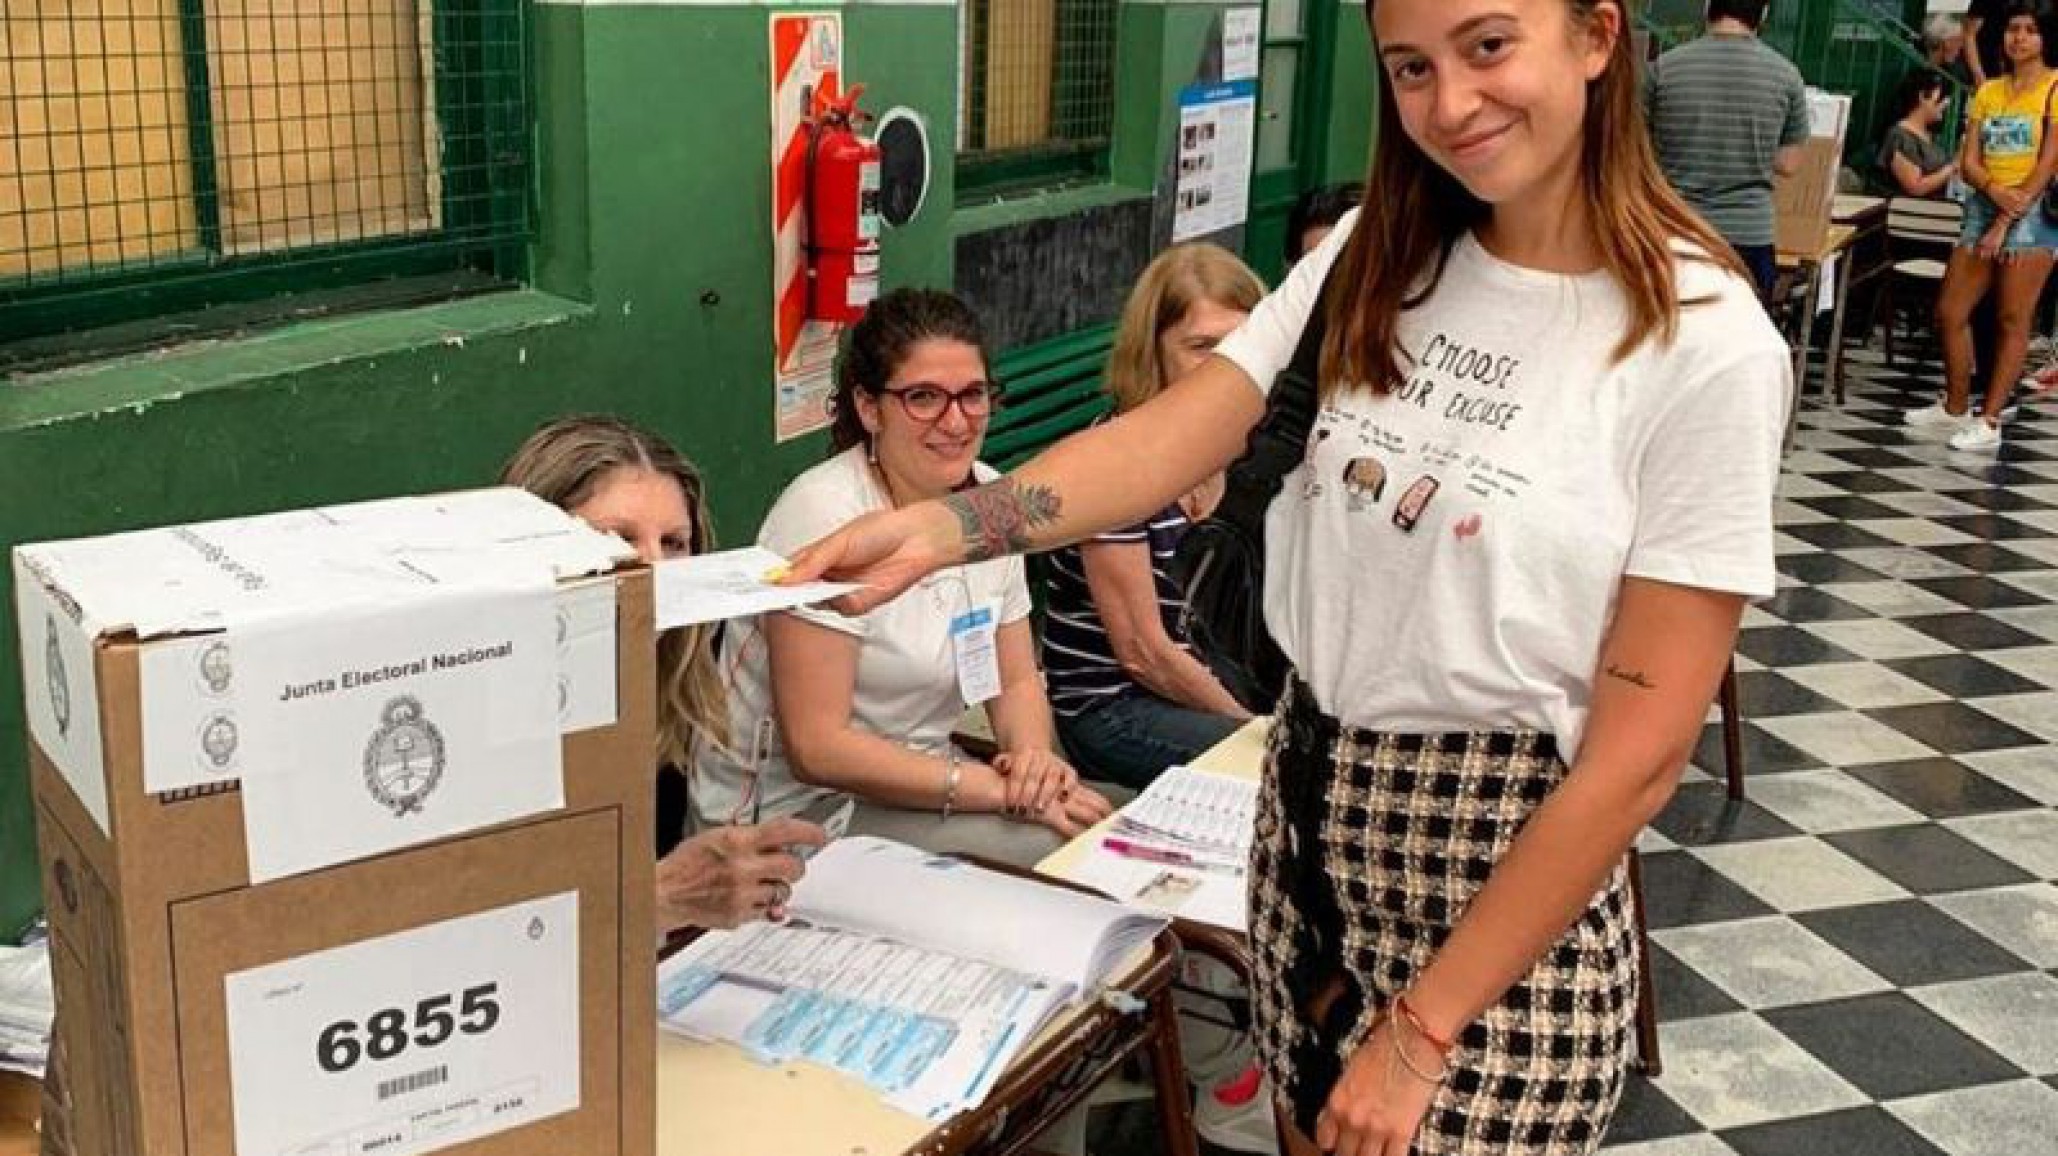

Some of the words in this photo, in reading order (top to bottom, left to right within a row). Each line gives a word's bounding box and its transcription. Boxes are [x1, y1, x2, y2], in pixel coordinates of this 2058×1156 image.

[1421, 333, 1519, 390] CHOOSE
[1388, 377, 1435, 408] UR
[1443, 391, 1523, 431] EXCUSE
[279, 679, 336, 701] Junta
[341, 656, 427, 689] Electoral
[431, 640, 513, 671] Nacional
[316, 981, 501, 1073] 6855
